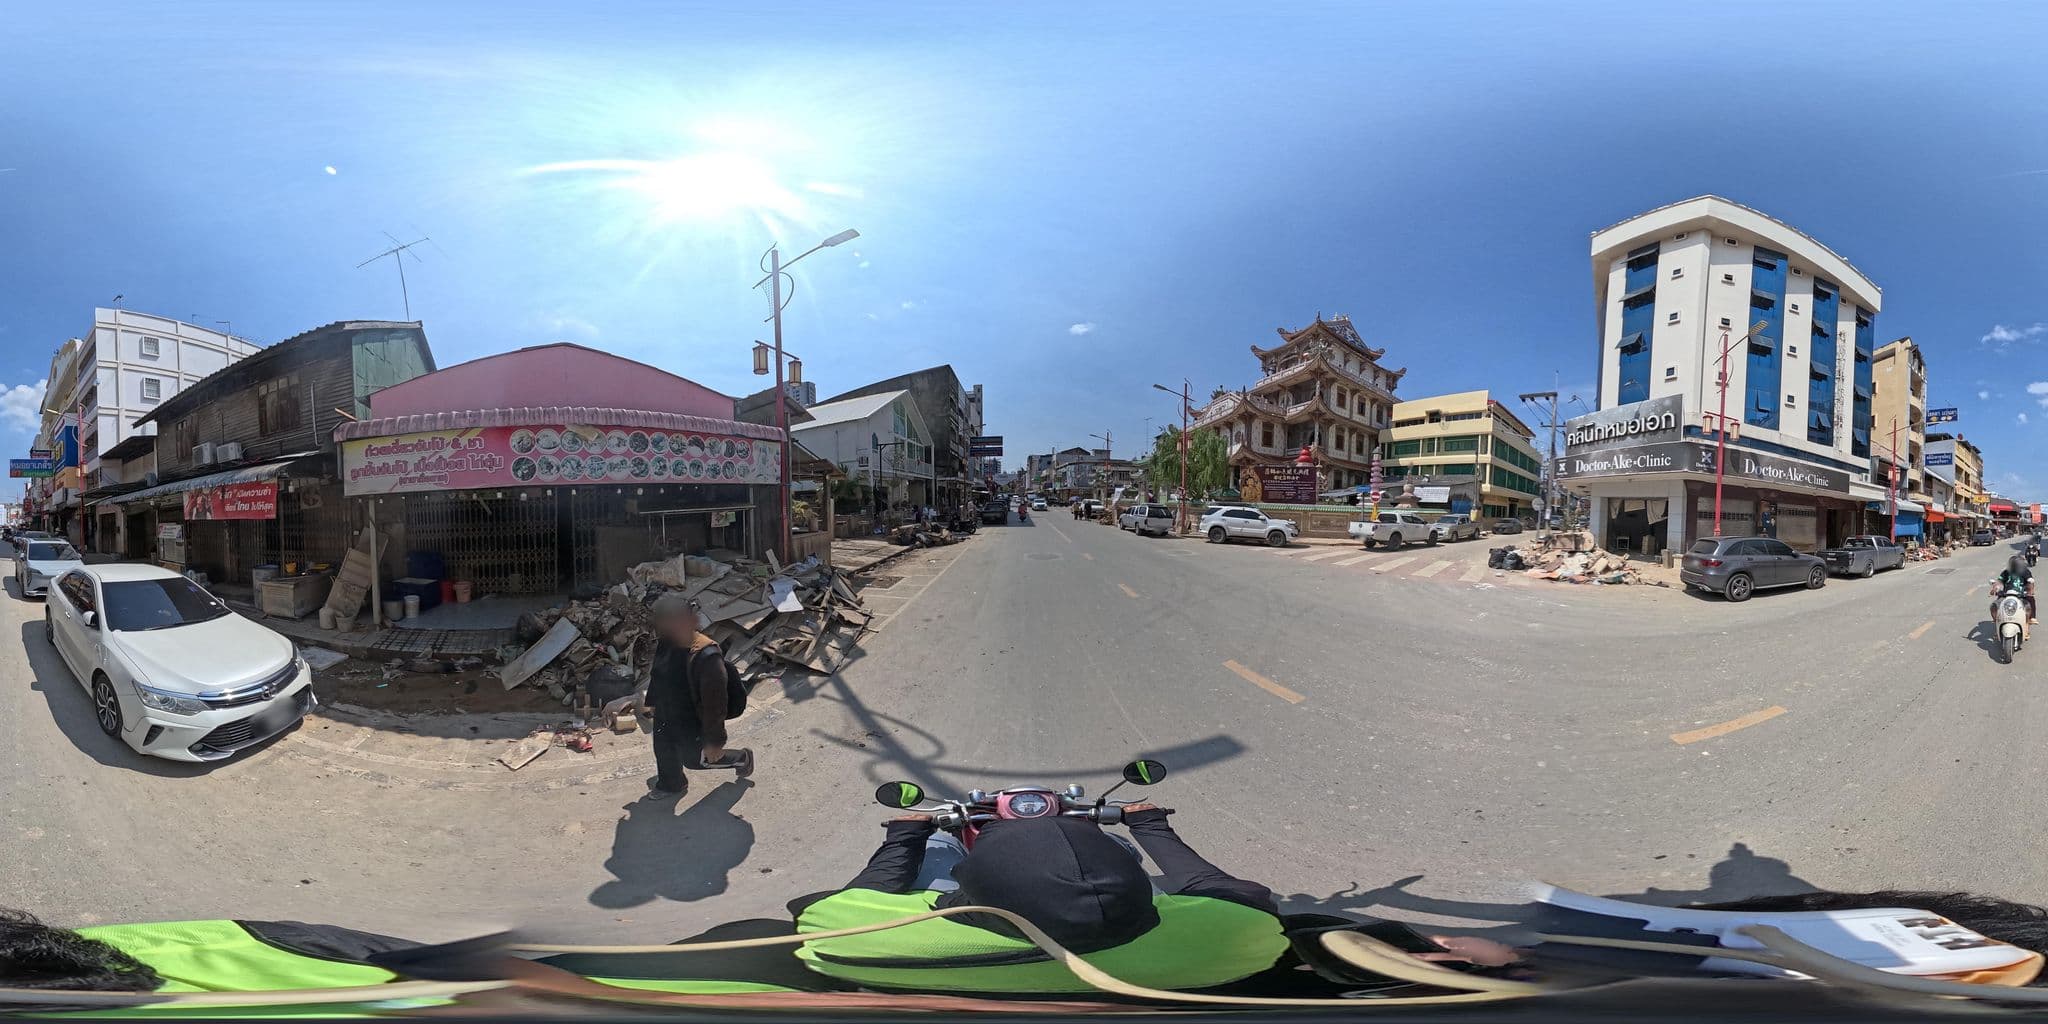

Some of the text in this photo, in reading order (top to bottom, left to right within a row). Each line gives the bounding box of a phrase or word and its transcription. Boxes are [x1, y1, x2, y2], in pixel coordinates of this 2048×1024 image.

[451, 437, 463, 449] &
[468, 453, 504, 472] ไก่ตุ๋น
[1575, 453, 1672, 473] Doctor Ake Clinic
[1744, 458, 1830, 487] Doctor Ake Clinic
[237, 500, 250, 511] ไทย
